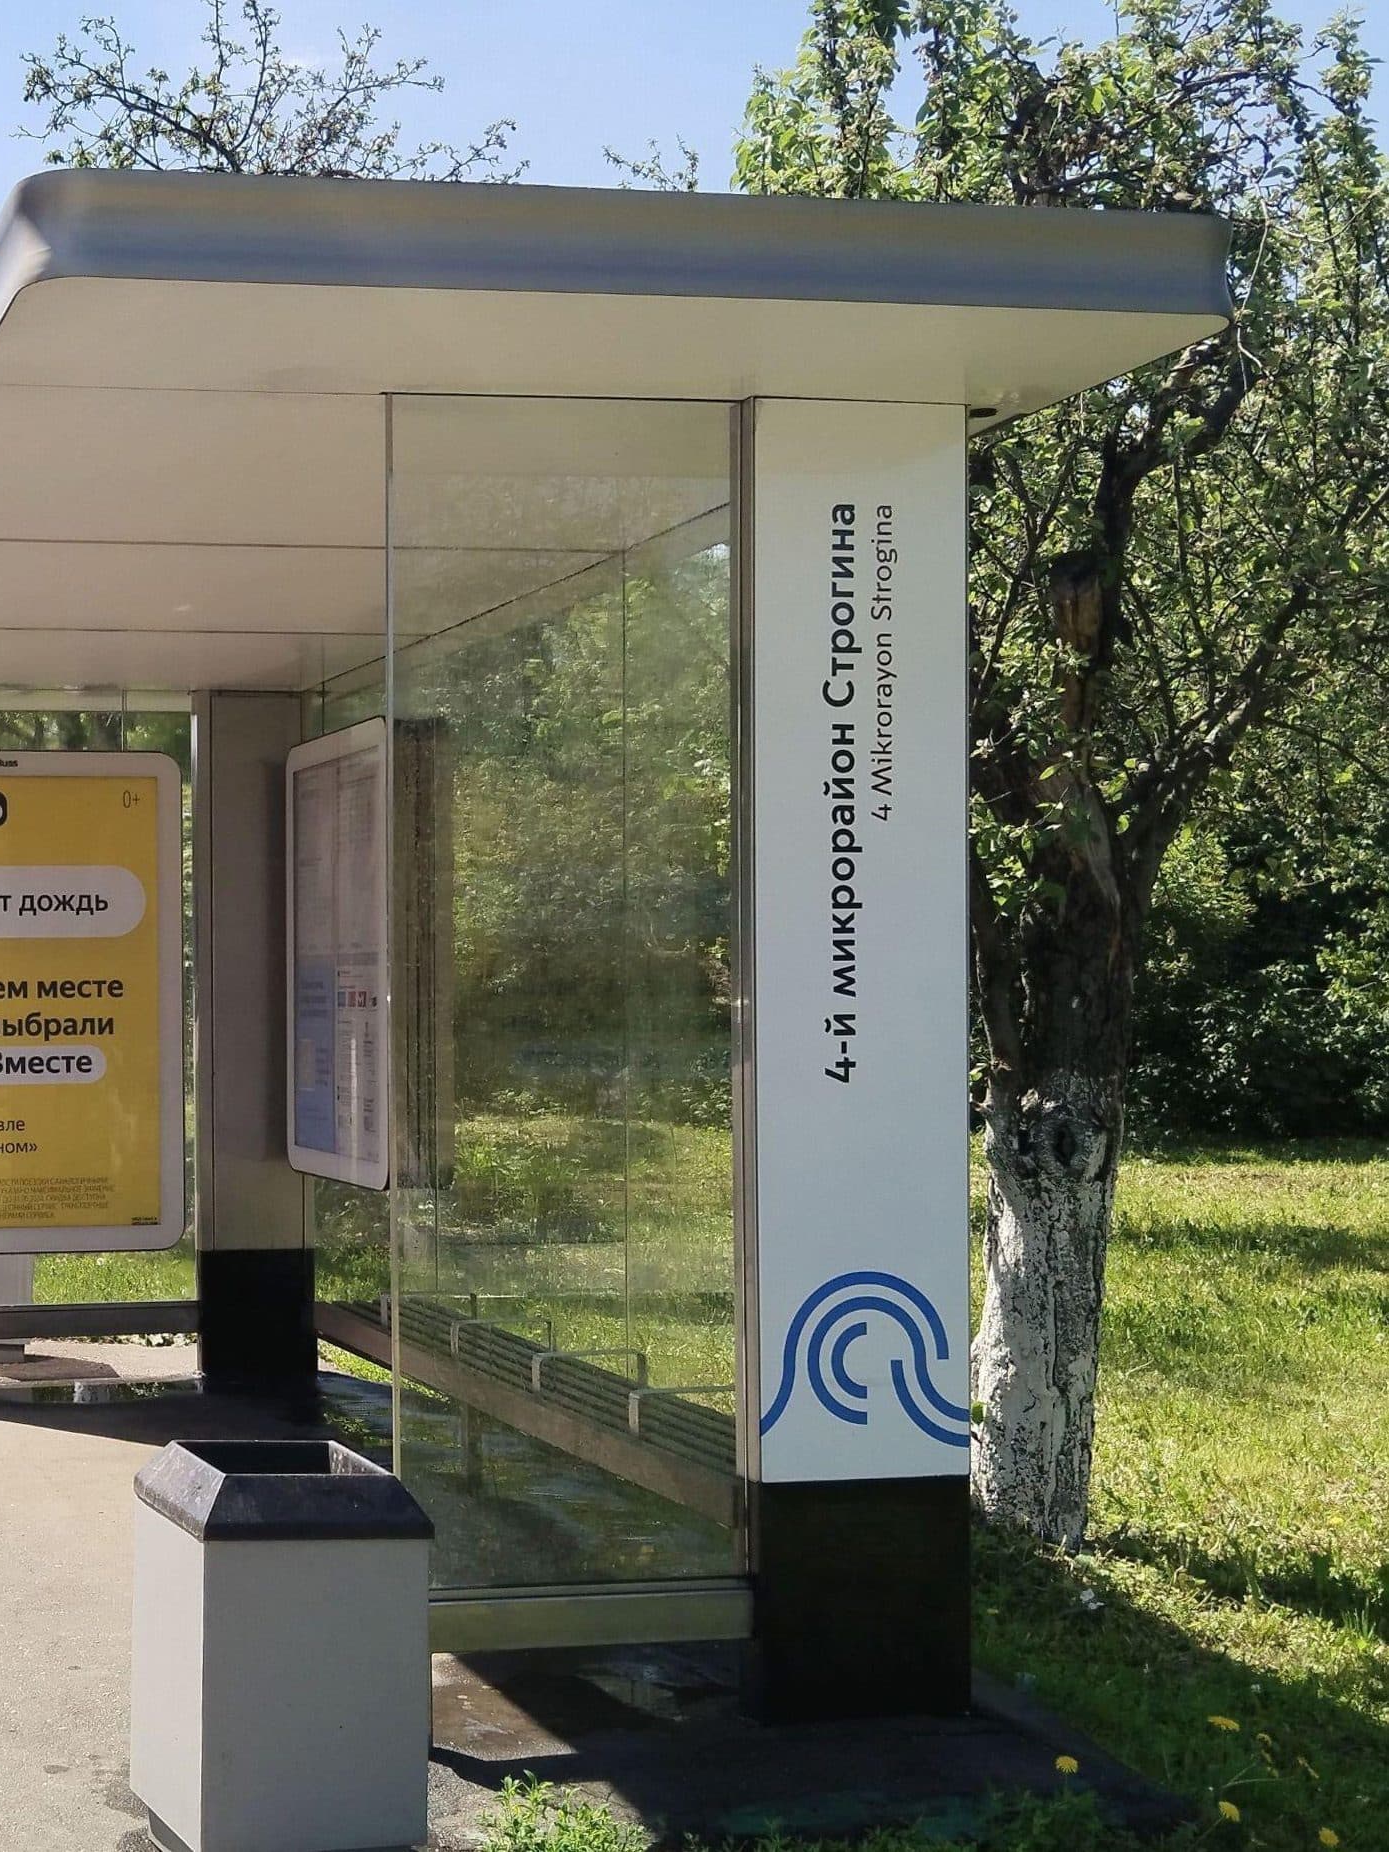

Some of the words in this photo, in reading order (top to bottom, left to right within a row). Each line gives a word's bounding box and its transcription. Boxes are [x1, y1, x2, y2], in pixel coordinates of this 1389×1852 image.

[870, 503, 898, 621] Strogina
[822, 502, 862, 708] Строгина
[870, 632, 897, 797] Mikrorayon
[122, 790, 141, 809] 0+
[871, 803, 892, 822] 4
[823, 721, 863, 998] микрорайон
[18, 890, 109, 917] дождь
[37, 977, 125, 999] месте
[824, 1012, 856, 1084] 4-й
